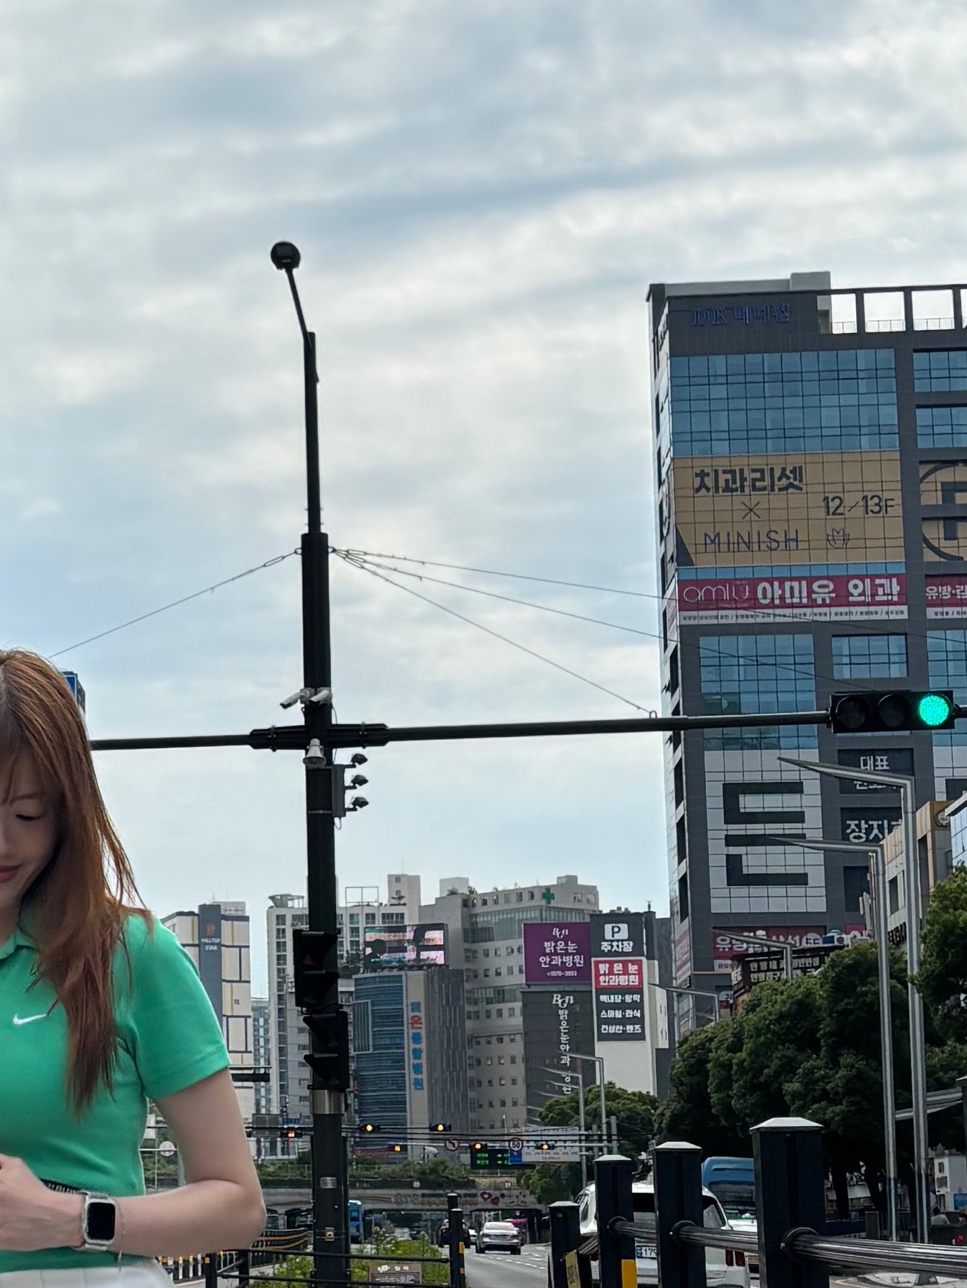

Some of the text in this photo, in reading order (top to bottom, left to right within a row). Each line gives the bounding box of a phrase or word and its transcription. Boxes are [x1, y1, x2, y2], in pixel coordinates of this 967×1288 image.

[694, 465, 804, 495] 치과리셋
[704, 529, 800, 553] MINISH
[756, 580, 835, 605] 아미유
[847, 577, 900, 602] 외과
[859, 755, 890, 771] 대표
[845, 819, 902, 843] 장지
[611, 925, 622, 938] P
[544, 941, 578, 954] 밝은눈
[600, 941, 634, 953] 주차장
[539, 955, 584, 968] 안과병원
